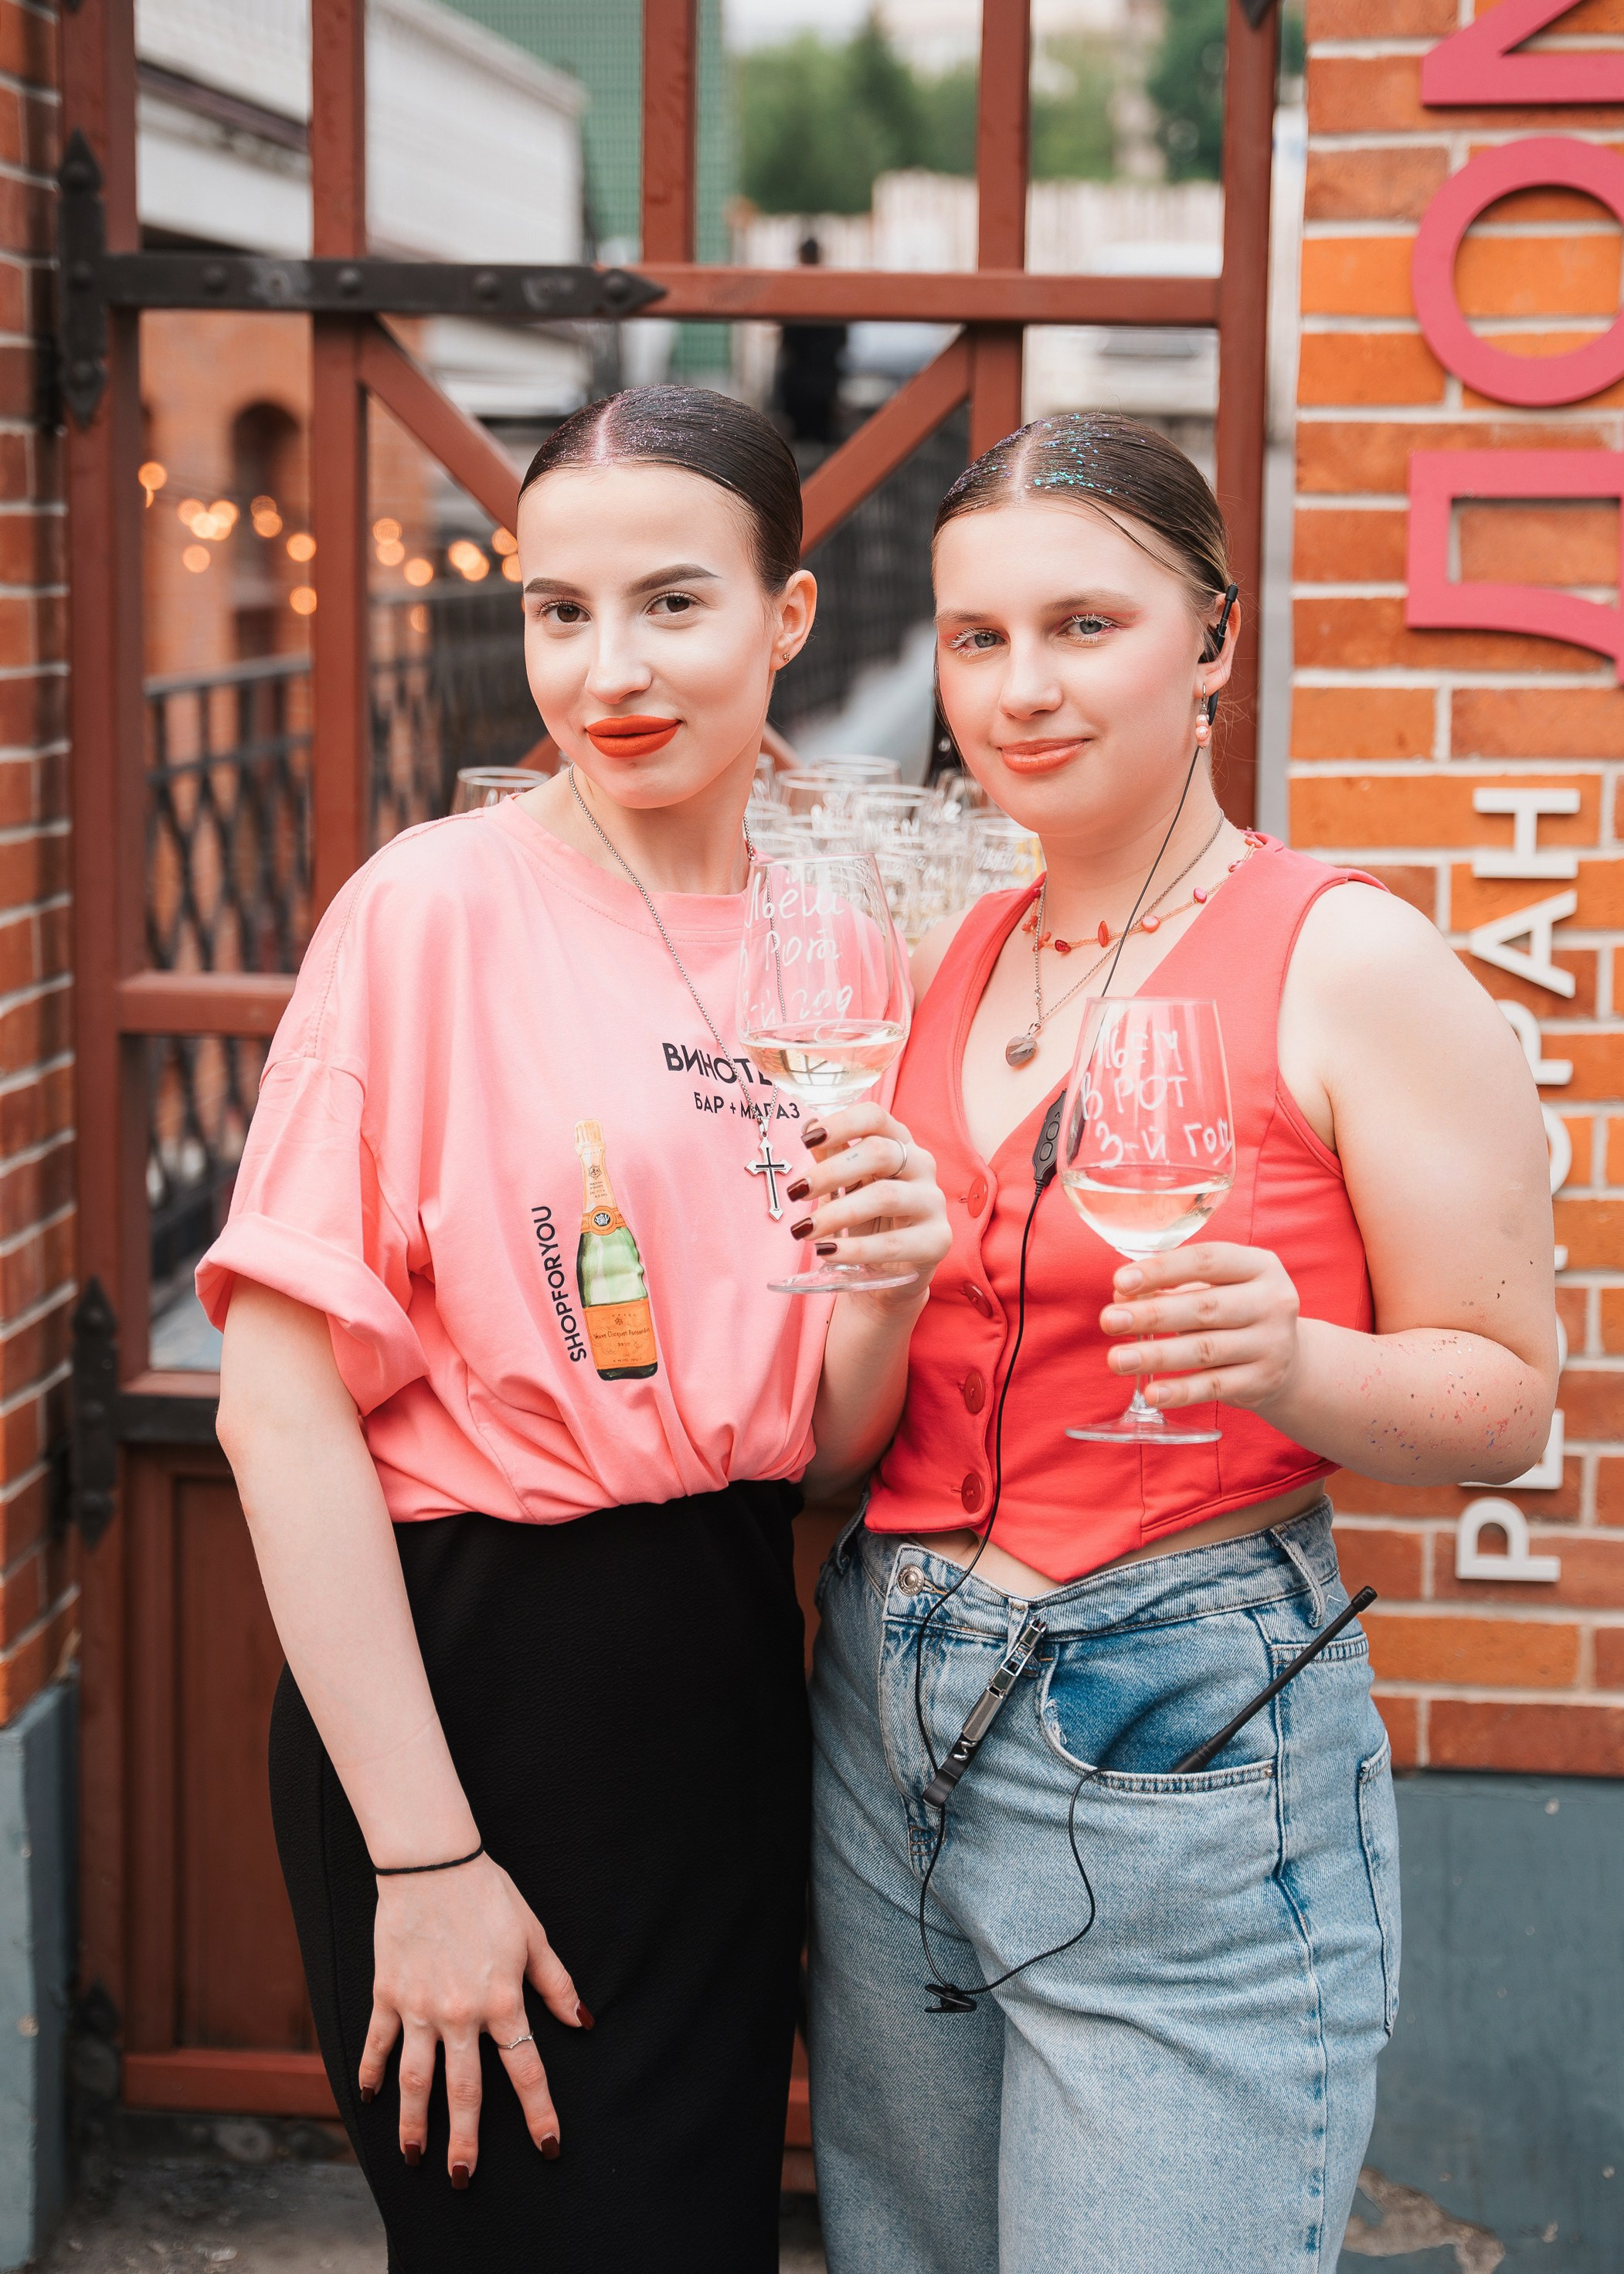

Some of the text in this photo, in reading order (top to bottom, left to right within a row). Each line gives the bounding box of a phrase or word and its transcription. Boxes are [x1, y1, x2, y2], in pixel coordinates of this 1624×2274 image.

[694, 1092, 725, 1114] БАР
[1113, 1075, 1188, 1113] РОТ
[531, 1205, 587, 1362] SHOPFORYOU
